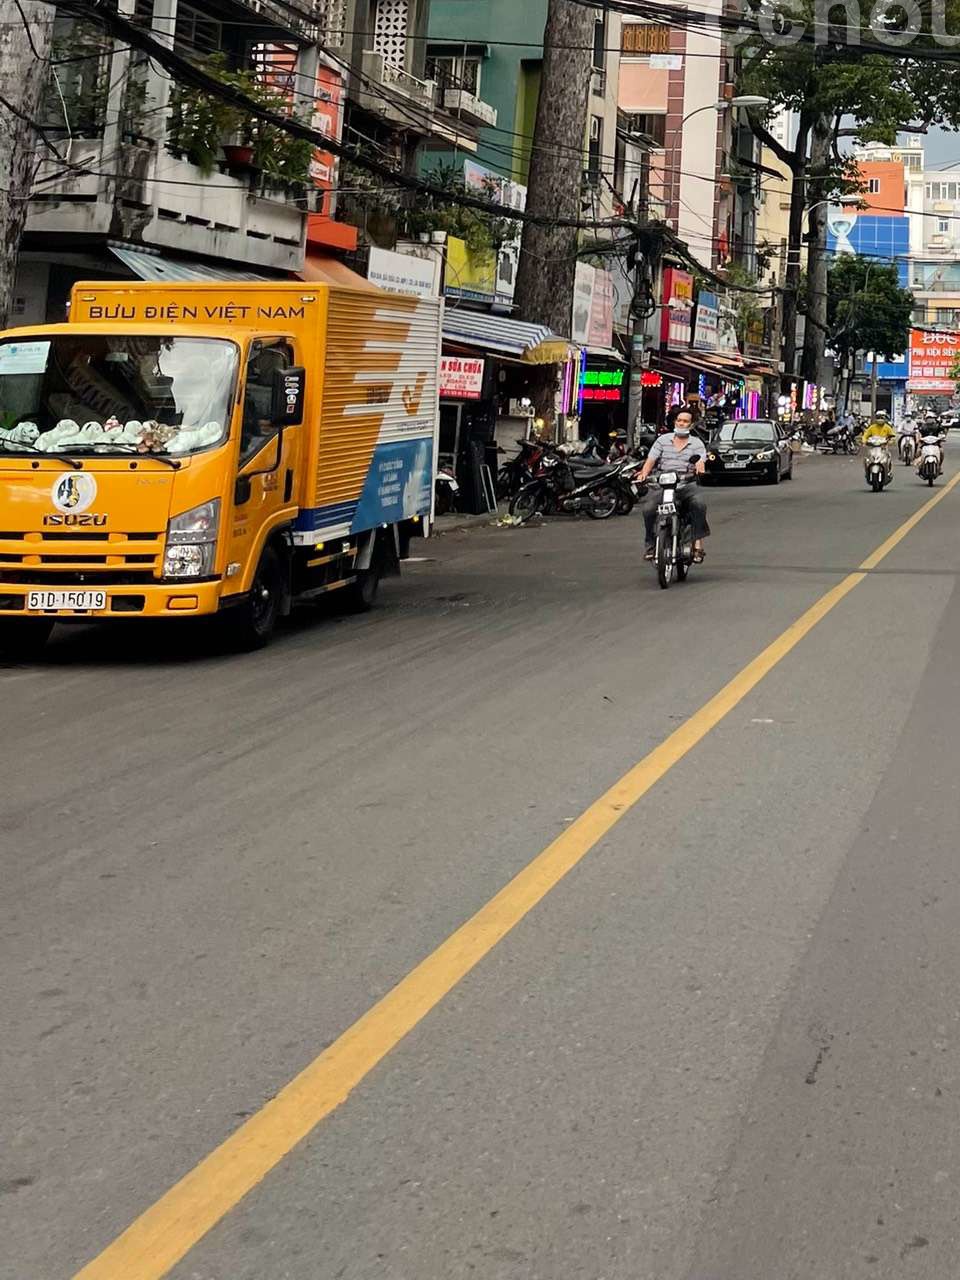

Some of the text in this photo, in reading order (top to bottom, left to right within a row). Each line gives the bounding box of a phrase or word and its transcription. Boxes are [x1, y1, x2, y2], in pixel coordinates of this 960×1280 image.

[89, 301, 304, 323] BƯU ĐIỆN VIỆT NAM
[42, 513, 108, 526] ISUZU
